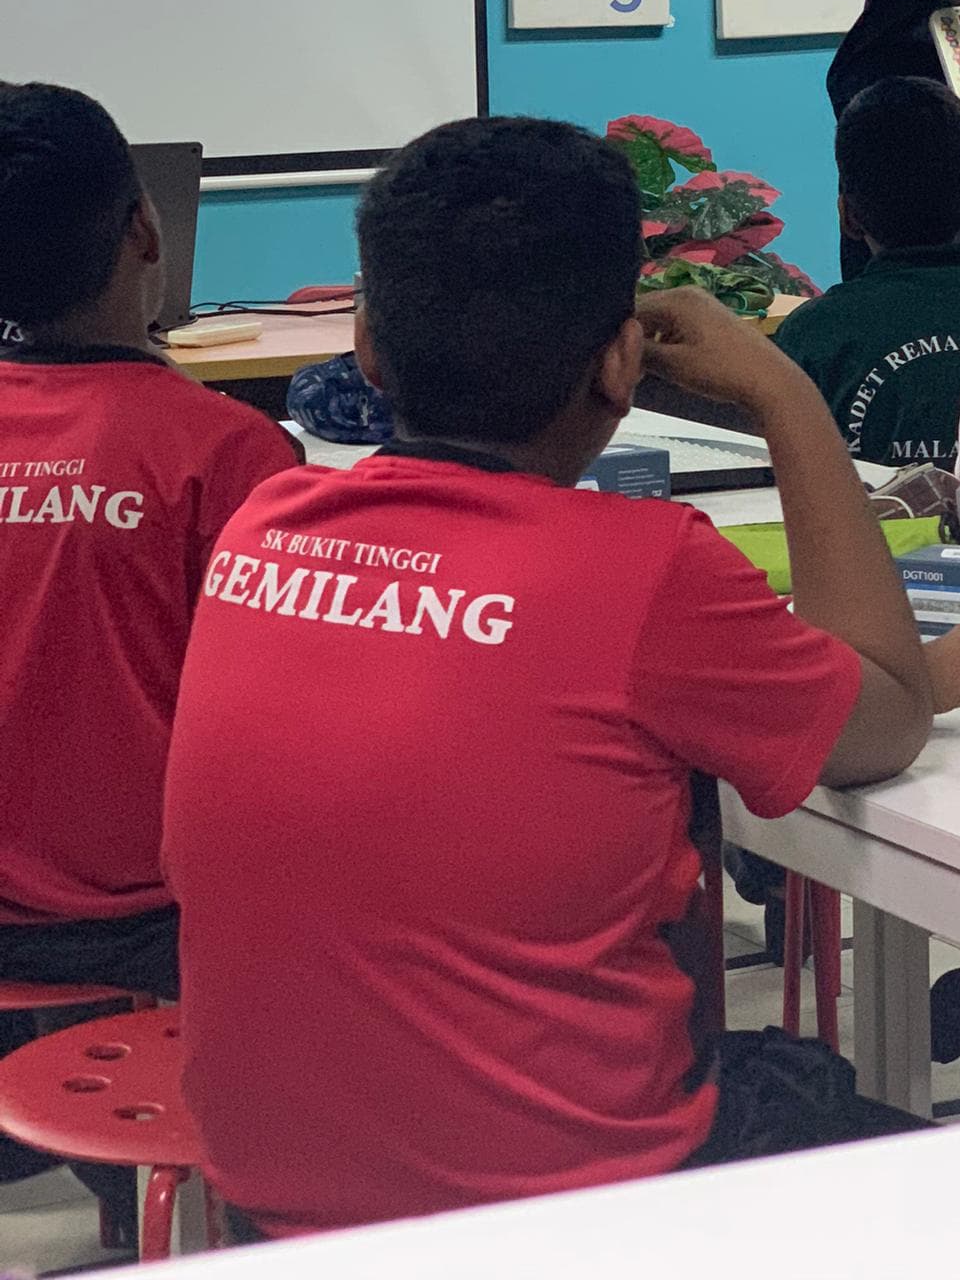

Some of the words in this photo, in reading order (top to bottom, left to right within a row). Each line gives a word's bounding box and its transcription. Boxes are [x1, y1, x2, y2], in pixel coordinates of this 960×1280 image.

[848, 368, 885, 453] KADET
[24, 459, 85, 477] TINGGI
[261, 529, 288, 550] SK
[288, 533, 353, 562] BUKIT
[353, 542, 442, 575] TINGGI
[203, 550, 516, 645] GEMILANG
